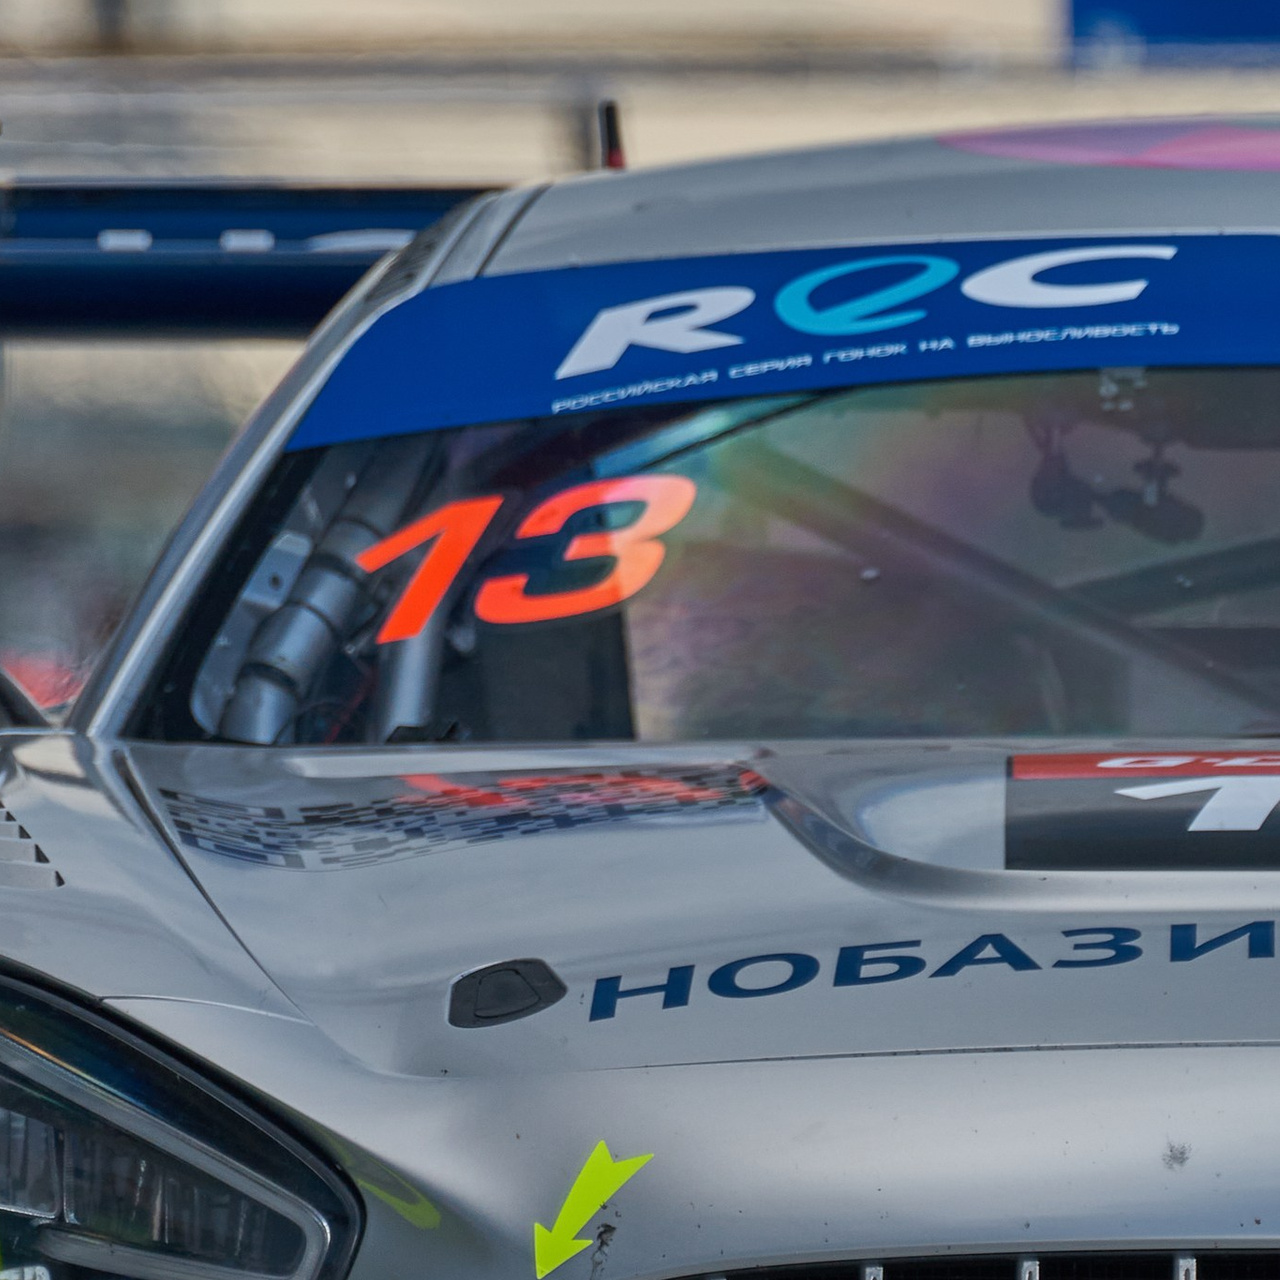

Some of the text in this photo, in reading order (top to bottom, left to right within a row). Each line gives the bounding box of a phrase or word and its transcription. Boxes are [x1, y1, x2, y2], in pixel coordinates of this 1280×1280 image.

[552, 322, 1180, 414] РОССИЙСКАЯ СЕРИЯ ГОНОК НА ВЫНОСЛИВОСТЬ
[355, 474, 697, 645] 13
[589, 920, 1275, 1022] НОБАЗИ
